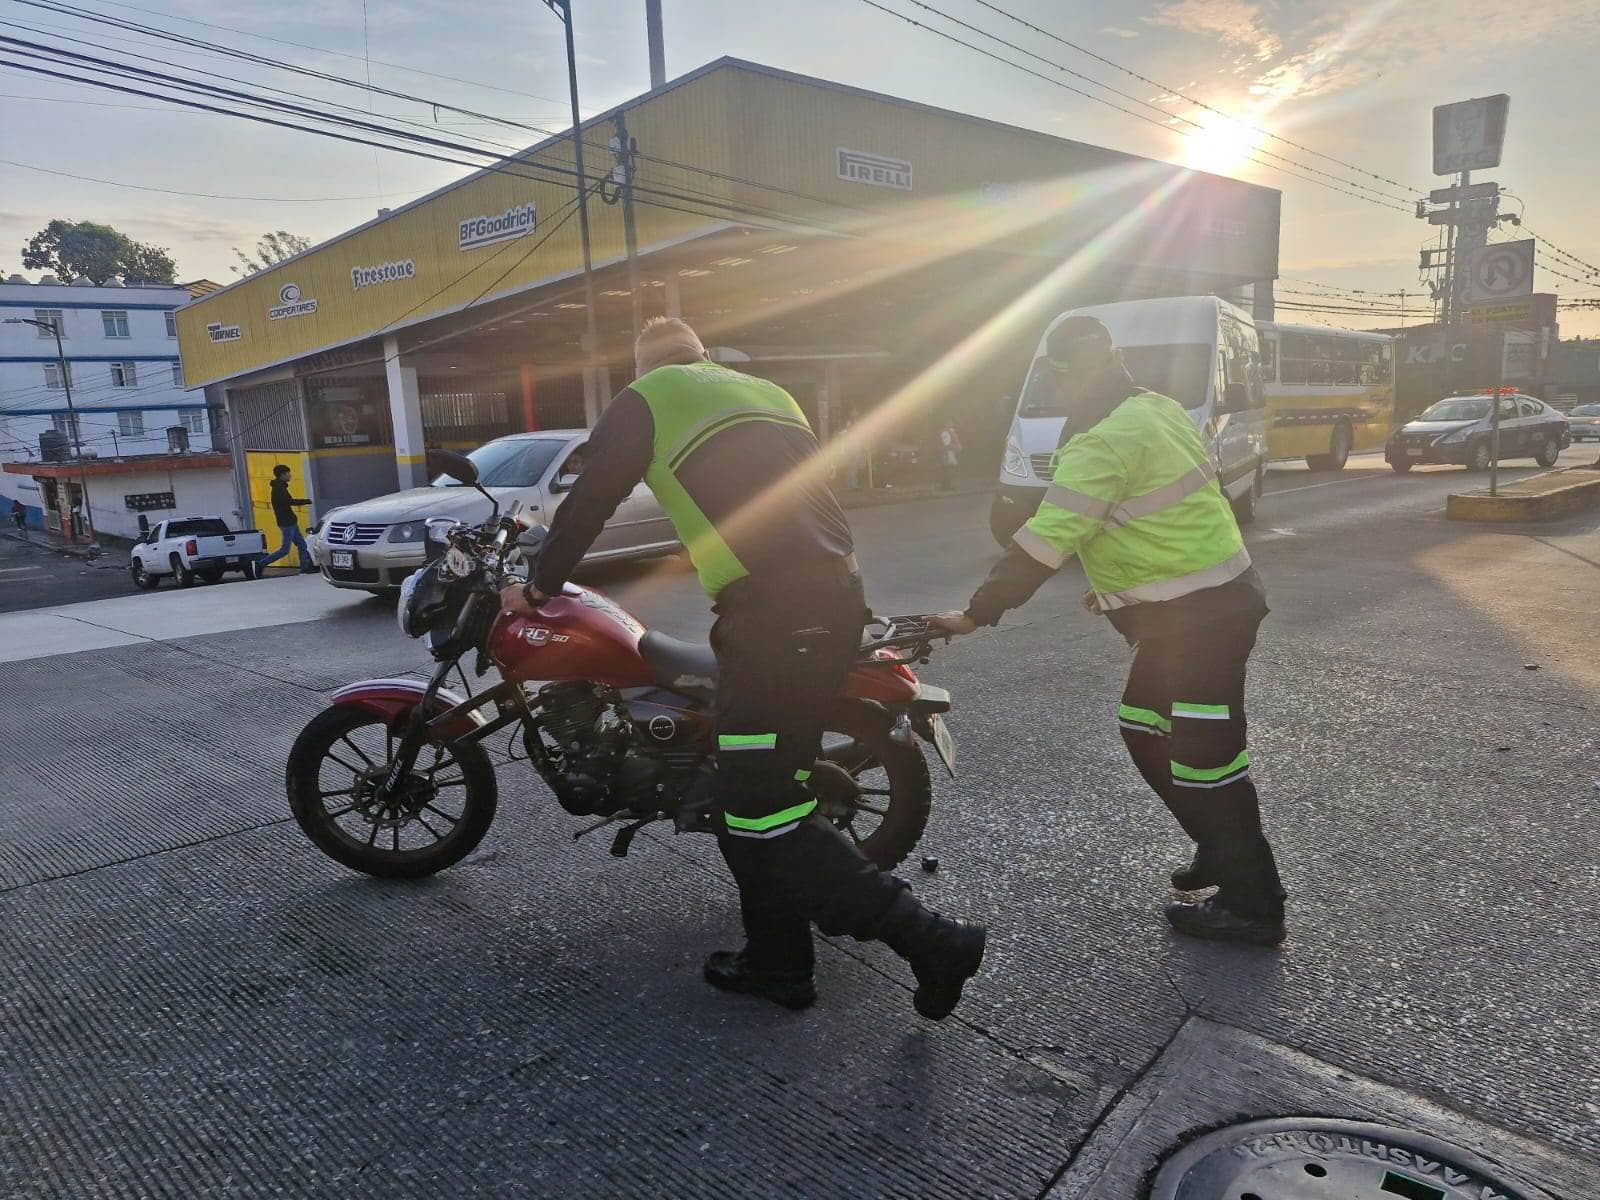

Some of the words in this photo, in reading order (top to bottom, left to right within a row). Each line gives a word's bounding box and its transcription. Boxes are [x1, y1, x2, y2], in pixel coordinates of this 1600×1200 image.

[839, 151, 911, 187] PIRELLI
[460, 206, 535, 240] BFGoodrich
[352, 260, 414, 286] Firestone
[1307, 1132, 1470, 1186] AASHTO
